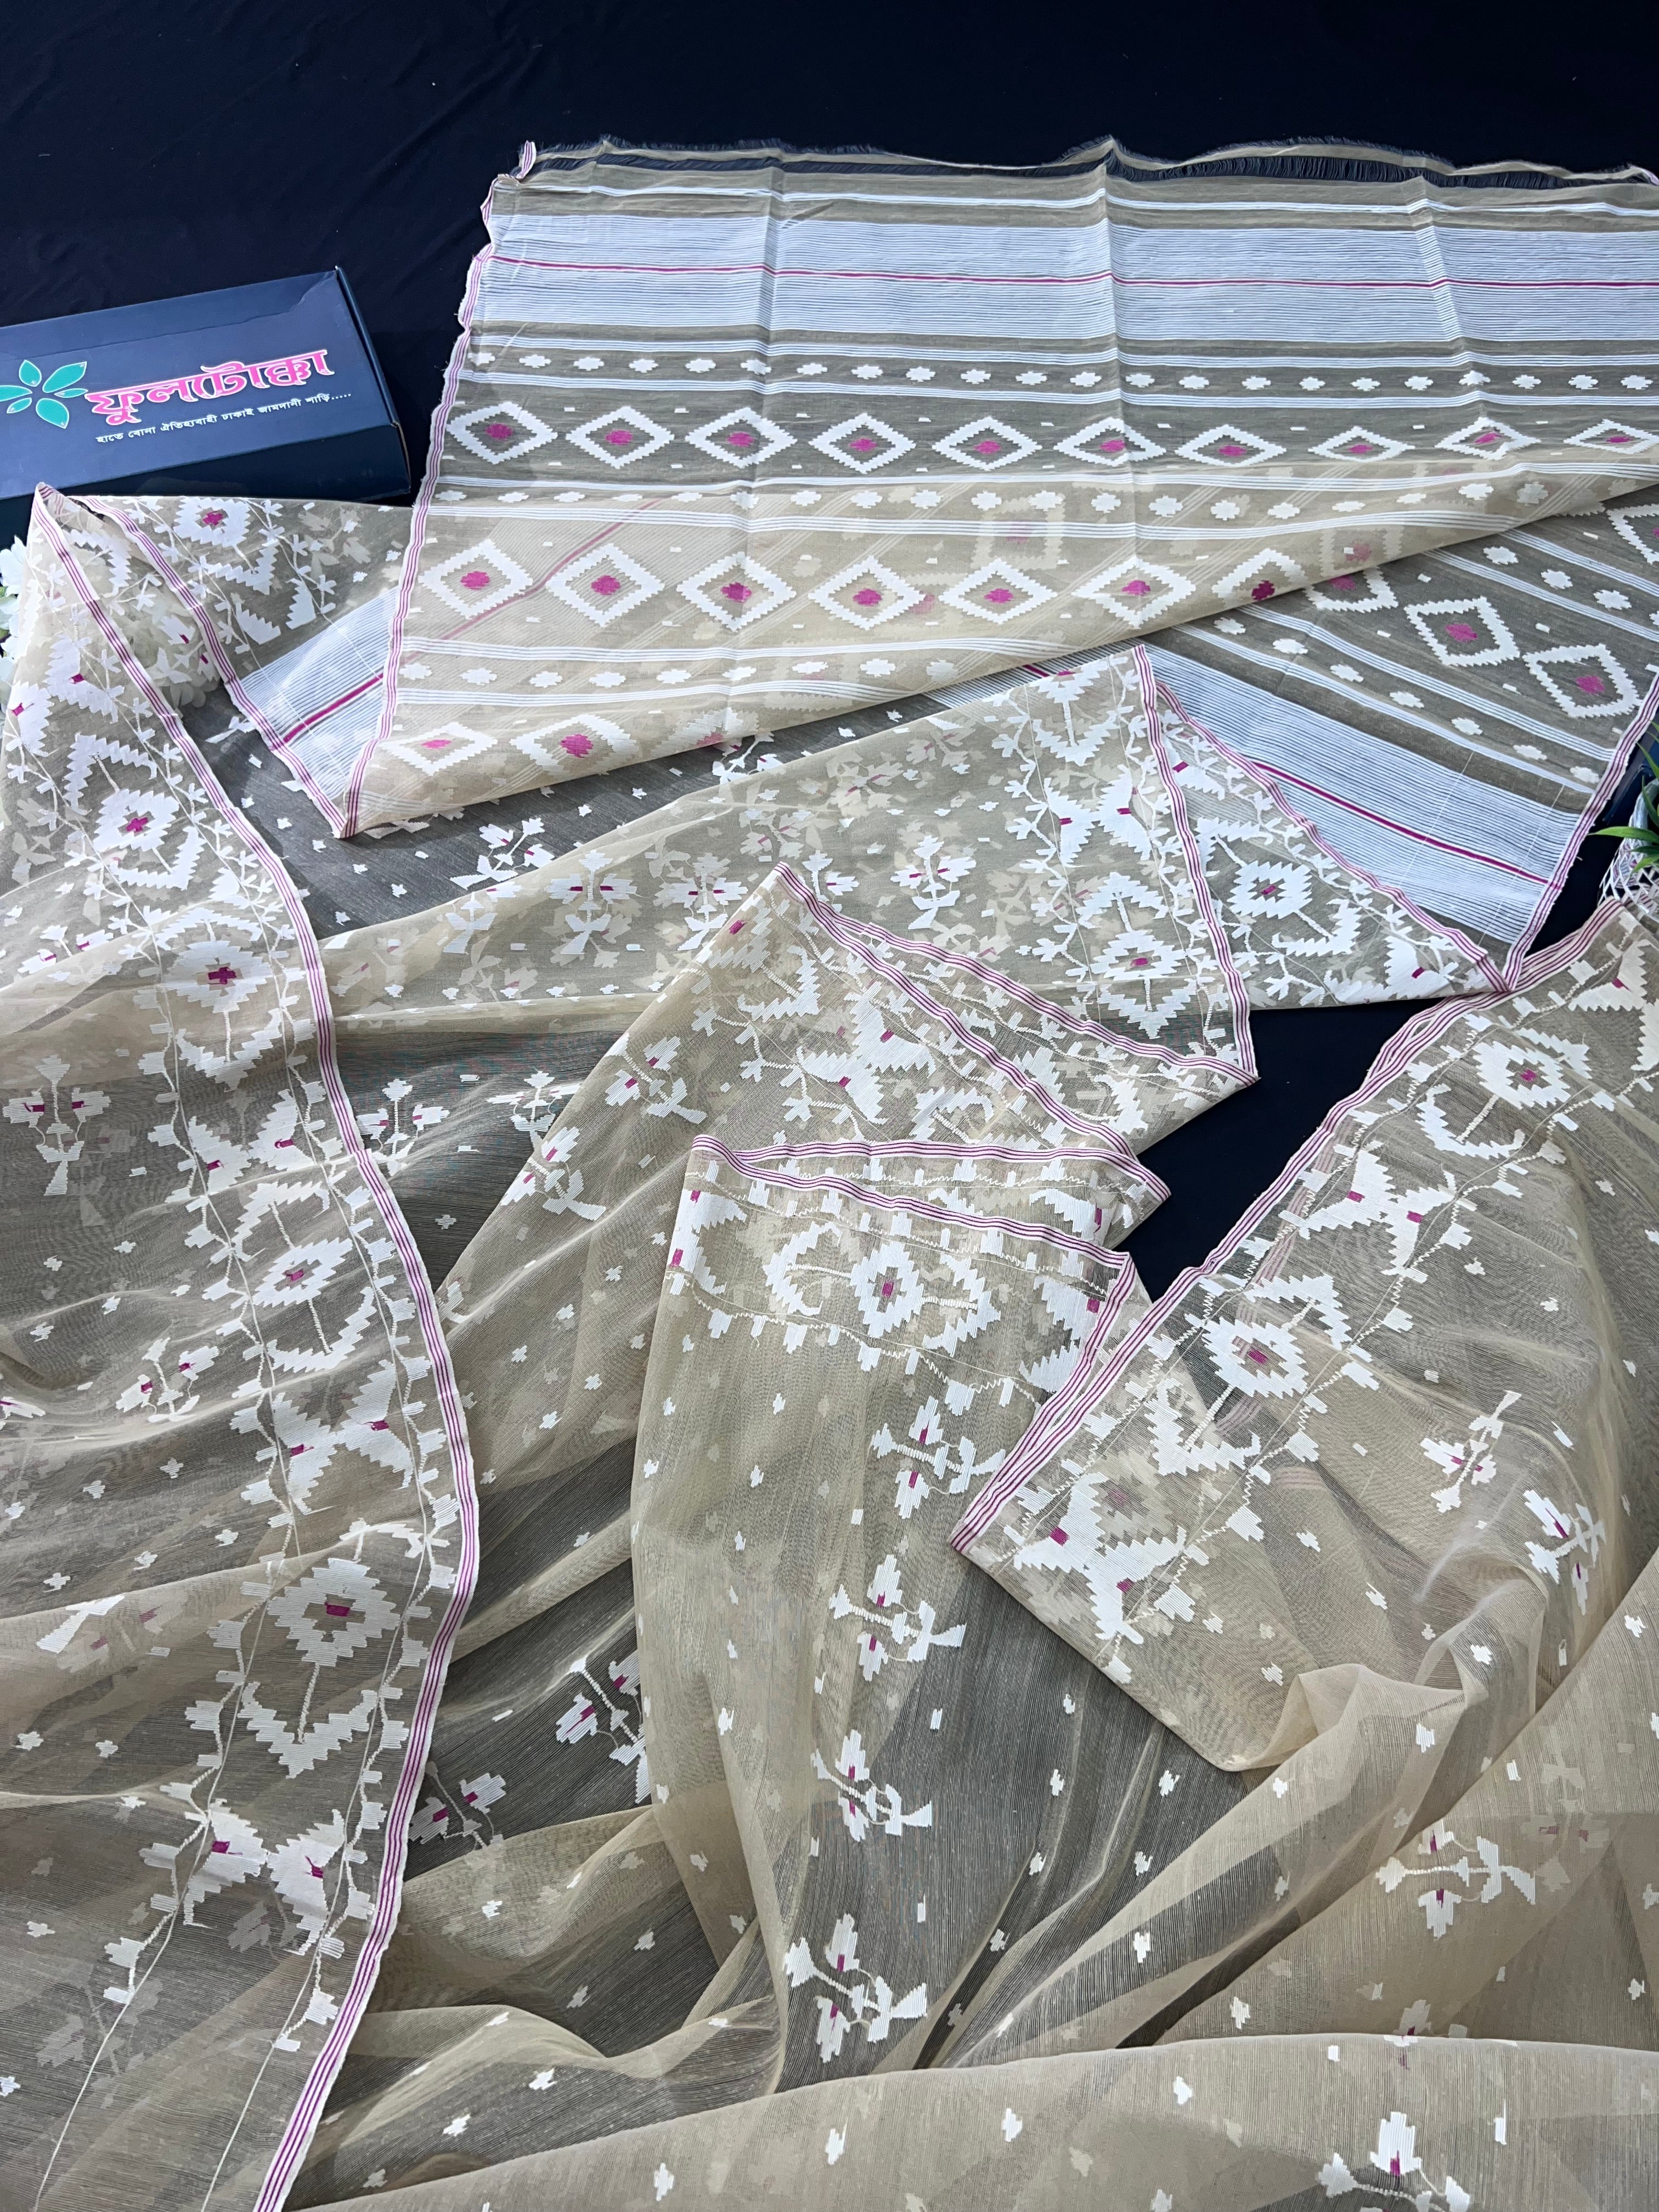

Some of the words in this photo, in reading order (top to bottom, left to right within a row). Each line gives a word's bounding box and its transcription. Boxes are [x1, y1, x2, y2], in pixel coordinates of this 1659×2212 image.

[95, 432, 124, 443] হাতে
[128, 426, 156, 438] বোনা
[160, 414, 218, 432] ঐতিহ্যবাহী
[221, 408, 255, 421] ঢাকাই
[257, 398, 302, 414] জামদানী
